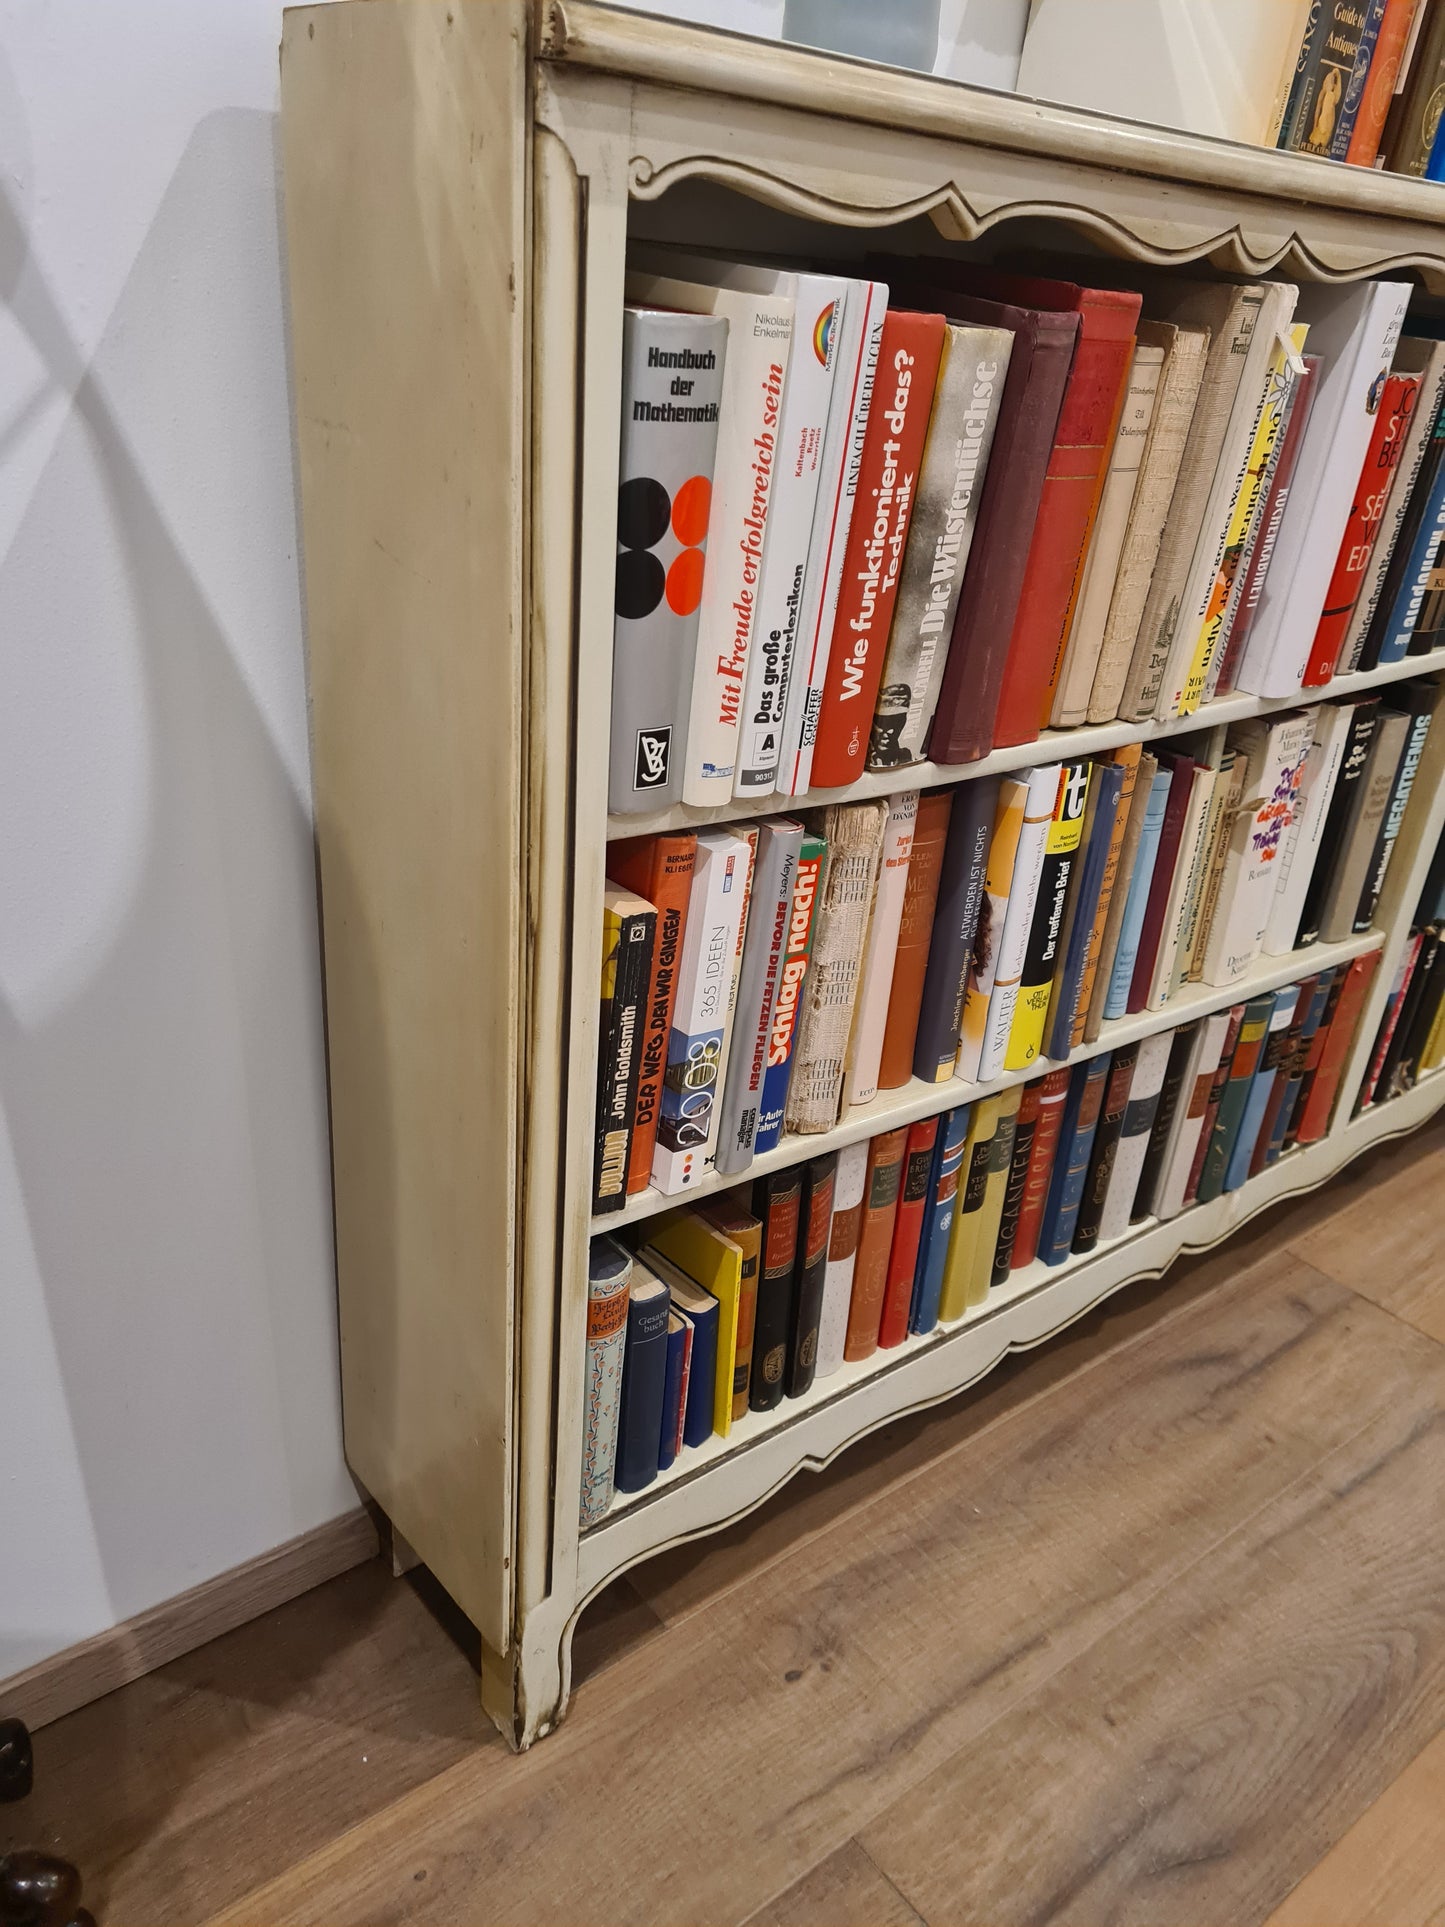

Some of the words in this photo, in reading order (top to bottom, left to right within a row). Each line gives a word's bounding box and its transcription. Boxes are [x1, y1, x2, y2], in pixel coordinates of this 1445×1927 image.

[1333, 1, 1360, 25] Guide
[1325, 31, 1359, 57] Antiques
[755, 313, 790, 327] Nikolaus
[648, 347, 716, 370] Handbuch
[670, 376, 694, 396] der
[762, 363, 784, 428] sein
[884, 349, 915, 434] das?
[633, 401, 720, 422] Mathematik
[795, 427, 808, 477] Kaltenbach
[807, 428, 815, 453] Reetz
[930, 361, 998, 584] Wüstenfüchse
[1199, 571, 1216, 616] Unser
[1213, 511, 1232, 567] großes
[1229, 366, 1275, 509] Weihnachtsbuch
[740, 431, 775, 585] erfolgreich
[882, 471, 914, 593] Technik
[850, 440, 901, 632] funktioniert
[920, 583, 952, 635] Die
[717, 590, 753, 682] Freude
[763, 630, 782, 686] große
[772, 564, 804, 723] Computerlexikon
[1201, 613, 1224, 668] Alpen
[840, 638, 869, 702] Wie
[719, 683, 741, 729] Mit
[754, 691, 774, 724] Das
[801, 688, 819, 747] SCHÄFFER
[761, 734, 775, 752] A
[754, 771, 774, 782] 90313
[1384, 713, 1433, 840] MEGATRENDS
[667, 854, 694, 863] BERNARD
[973, 825, 988, 865] NICHTS
[778, 853, 794, 898] Meyers:
[969, 865, 980, 886] IST
[1058, 859, 1071, 887] Brief
[771, 901, 788, 953] BEVOR
[960, 888, 976, 940] ALTWERDEN
[1046, 886, 1066, 936] treffende
[659, 908, 681, 966] GINGEN
[705, 925, 725, 981] IDEEN
[1042, 936, 1055, 961] Der
[654, 969, 674, 999] WIR
[766, 951, 779, 980] DIE
[767, 958, 806, 1068] Schlag
[788, 862, 818, 954] nach!
[957, 948, 971, 994] Fuchsberger
[650, 1000, 668, 1030] DEN
[700, 984, 718, 1018] 365
[758, 980, 774, 1034] FETZEN
[951, 994, 964, 1034] Joachim
[993, 990, 1014, 1053] WALTER
[614, 1003, 637, 1081] Goldsmith
[748, 1034, 767, 1092] FLIEGEN
[610, 1085, 628, 1120] John
[636, 1083, 658, 1127] DER
[677, 1036, 721, 1146] 2008
[765, 1109, 785, 1121] Auto-
[737, 1109, 750, 1146] manager
[744, 1107, 757, 1149] campus
[598, 1128, 630, 1199] BULLION
[1023, 1111, 1061, 1213] MOSKAU
[994, 1134, 1035, 1271] GIGANTEN
[643, 1319, 664, 1334] buch
